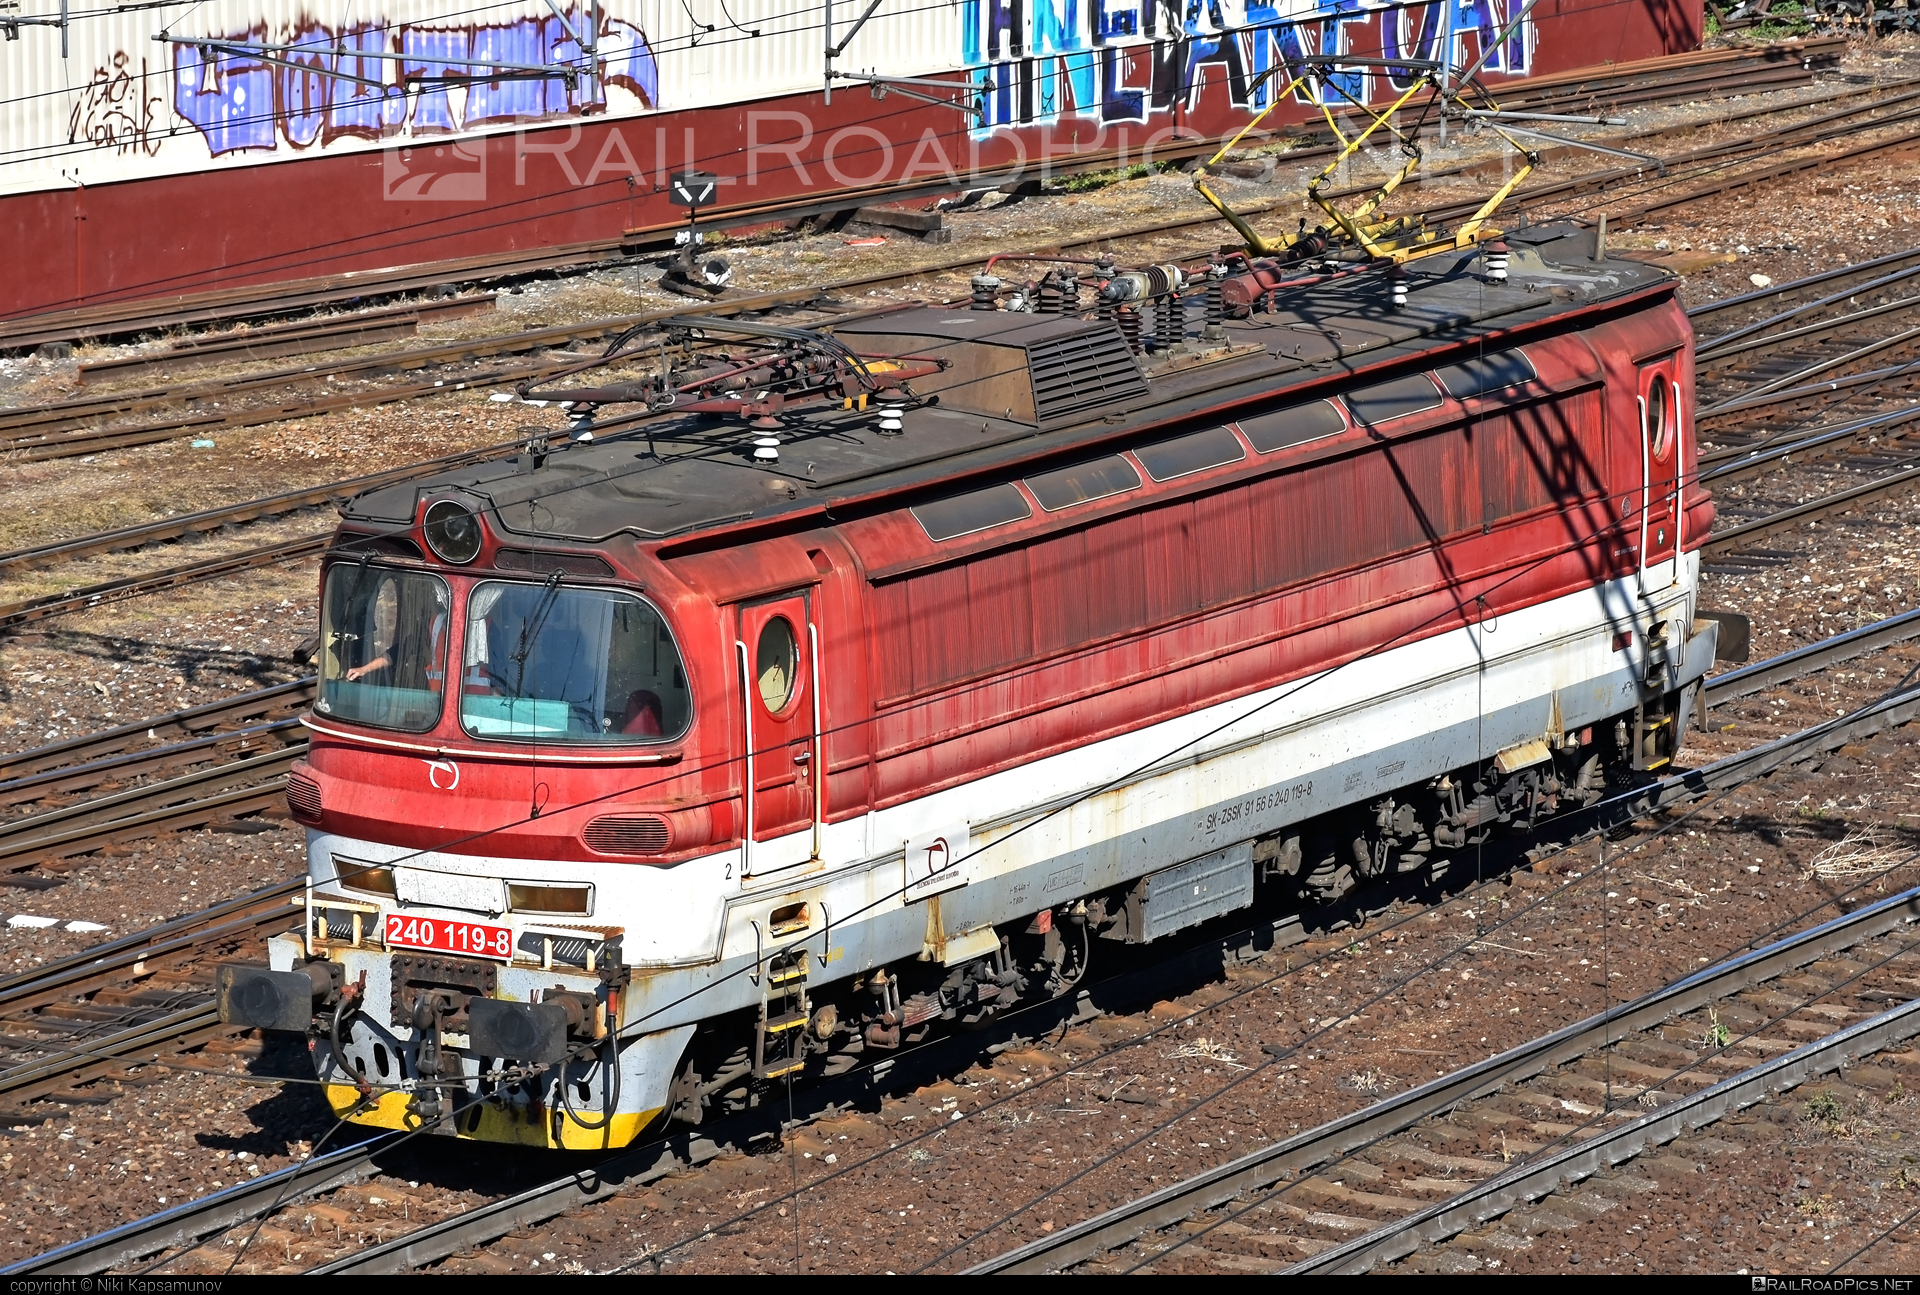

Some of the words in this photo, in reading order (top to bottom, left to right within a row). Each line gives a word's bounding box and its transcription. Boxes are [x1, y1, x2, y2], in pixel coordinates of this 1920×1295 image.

[1206, 803, 1243, 830] SK-ZSSK
[1244, 799, 1254, 817] 91
[1256, 796, 1267, 812] 56
[1267, 793, 1273, 809] 6
[1274, 788, 1290, 807] 240
[1291, 780, 1313, 801] 119-8
[725, 862, 732, 881] 2
[387, 917, 435, 946] 240
[443, 923, 511, 955] 119-8
